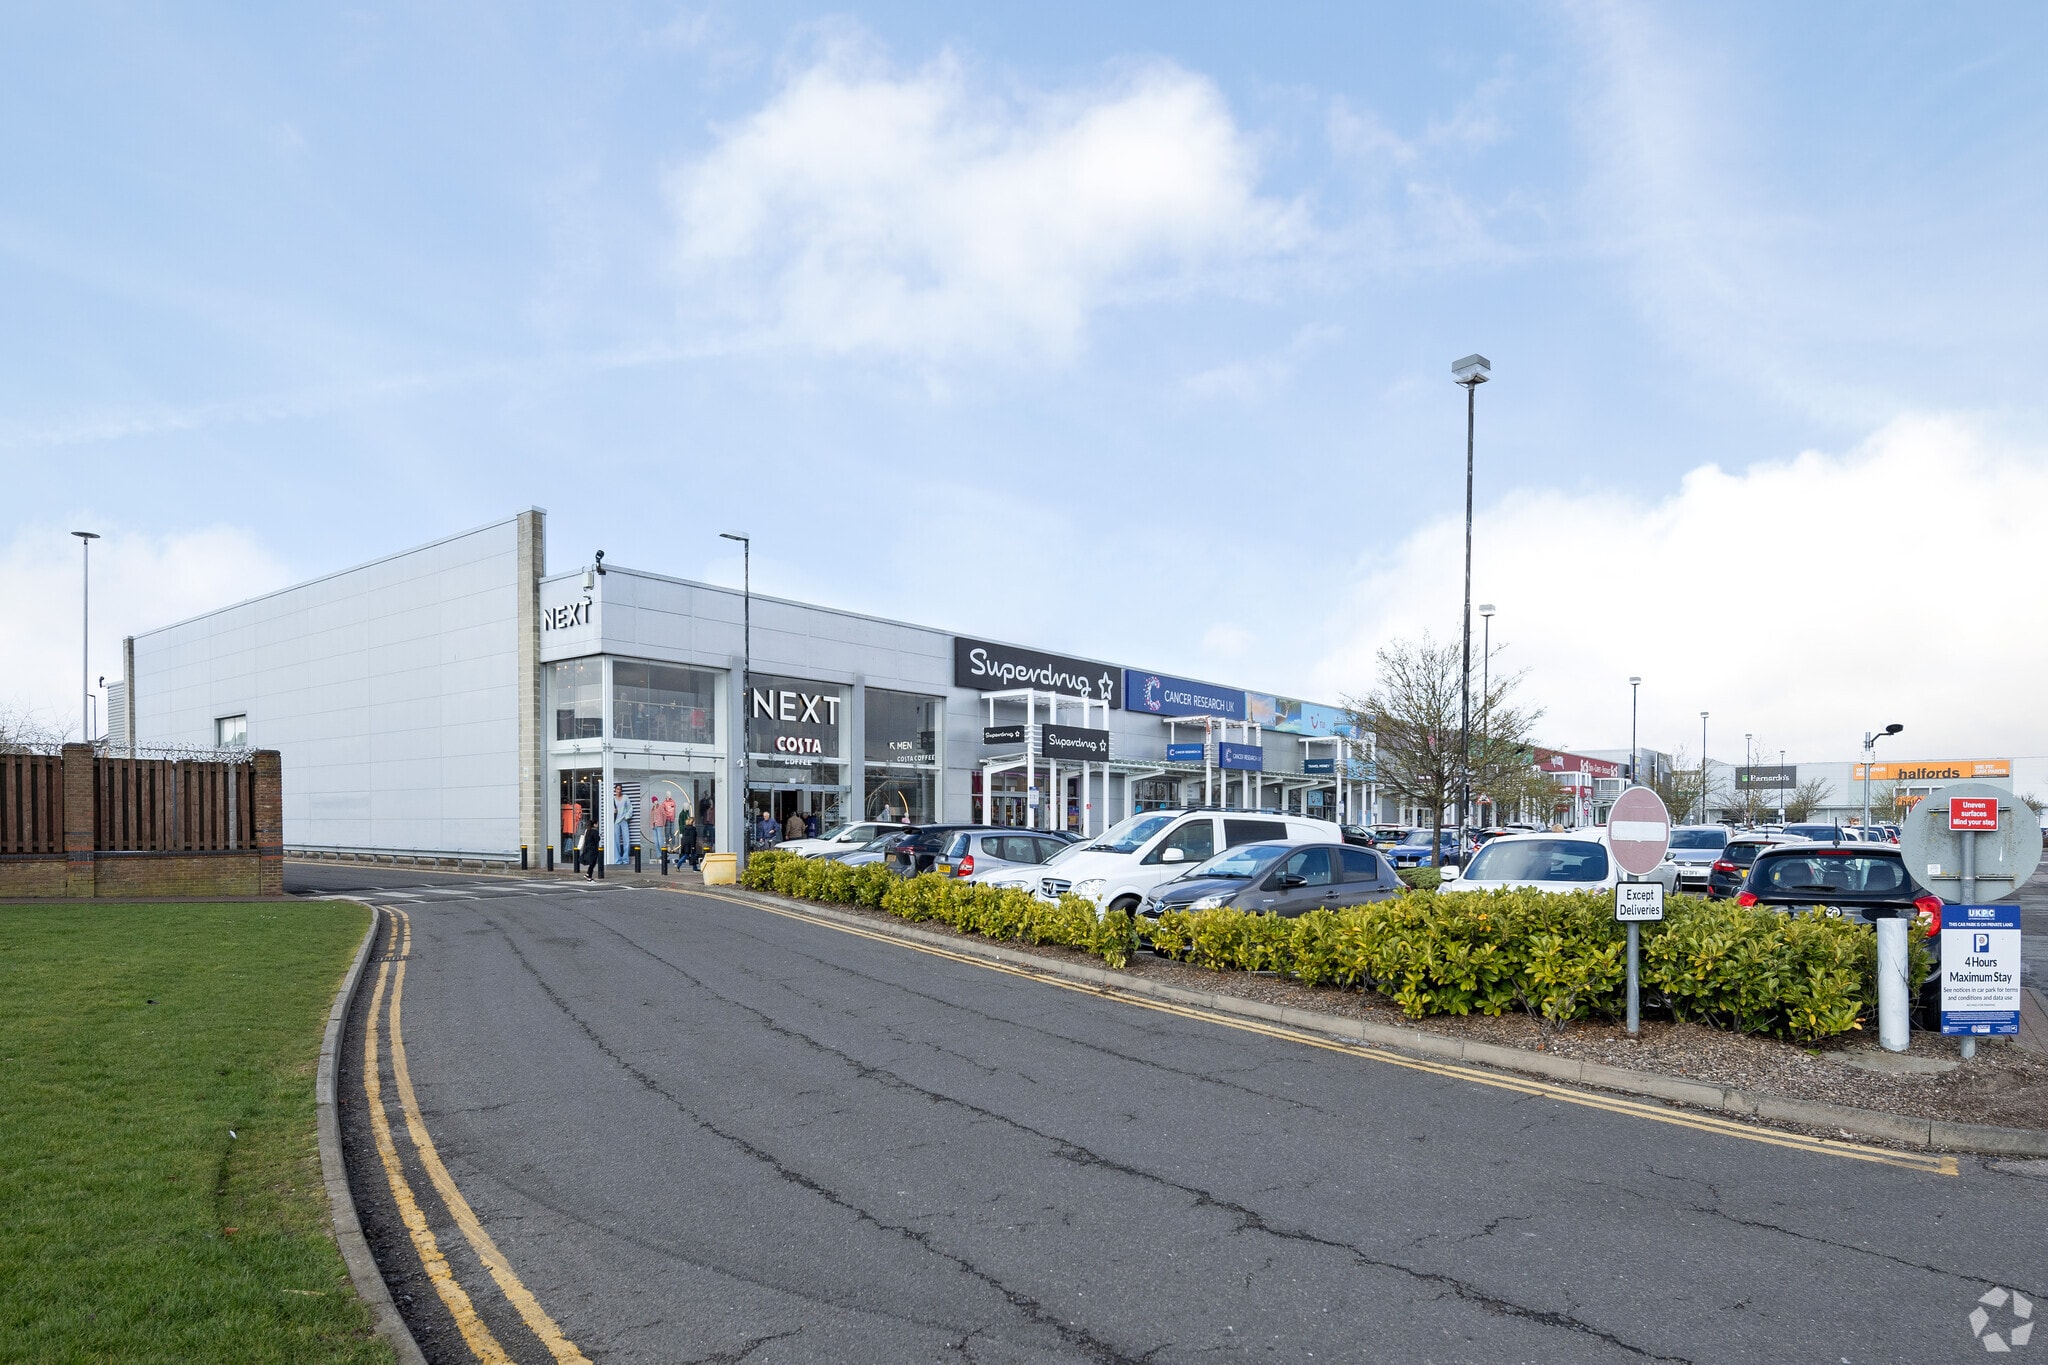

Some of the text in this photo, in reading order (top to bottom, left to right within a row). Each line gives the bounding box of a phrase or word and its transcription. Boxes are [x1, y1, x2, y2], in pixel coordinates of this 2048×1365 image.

[543, 600, 592, 631] NEXT
[969, 648, 1092, 697] Superdrug
[752, 687, 841, 725] NEXT
[1164, 690, 1235, 712] CANCER RESEARCH UK
[775, 736, 822, 754] COSTA
[896, 741, 913, 750] MEN
[1049, 733, 1097, 752] Superdrug
[1898, 768, 1960, 780] halfords
[1962, 801, 1985, 809] Uneven
[1626, 889, 1654, 902] Except
[1620, 904, 1660, 915] Deliveries
[1969, 909, 1995, 917] UKPC
[1965, 957, 1998, 968] 4 Hours
[1949, 971, 2013, 984] Maximum Stay
